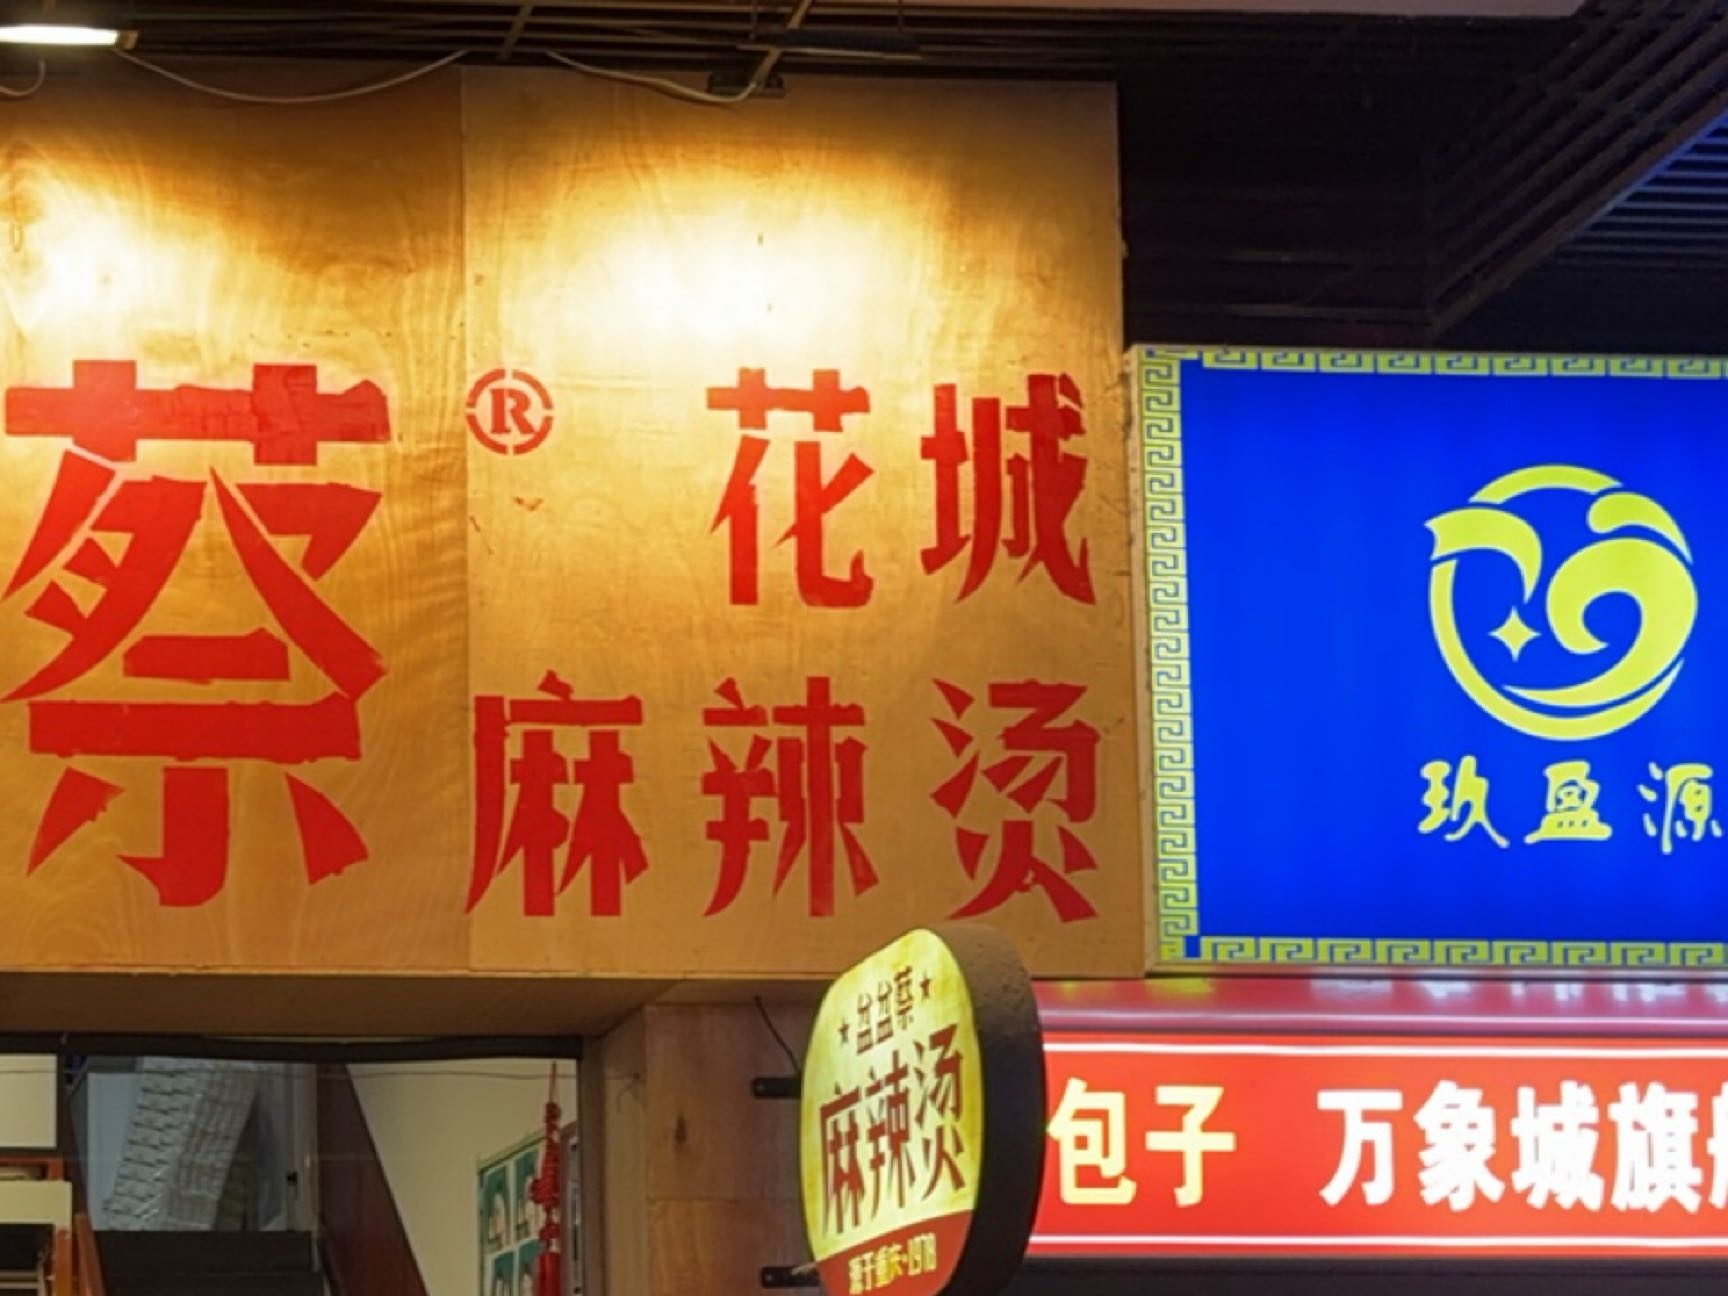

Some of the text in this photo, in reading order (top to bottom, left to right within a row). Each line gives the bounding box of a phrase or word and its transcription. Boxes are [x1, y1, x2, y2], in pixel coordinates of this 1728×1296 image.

[706, 367, 1096, 607] 花城
[464, 670, 1098, 922] 麻辣烫
[1418, 755, 1725, 855] 玖盈源
[856, 965, 914, 1055] 盆盆蔡
[819, 1022, 966, 1241] 麻辣烫
[1047, 1078, 1728, 1214] 包子 万象城旗
